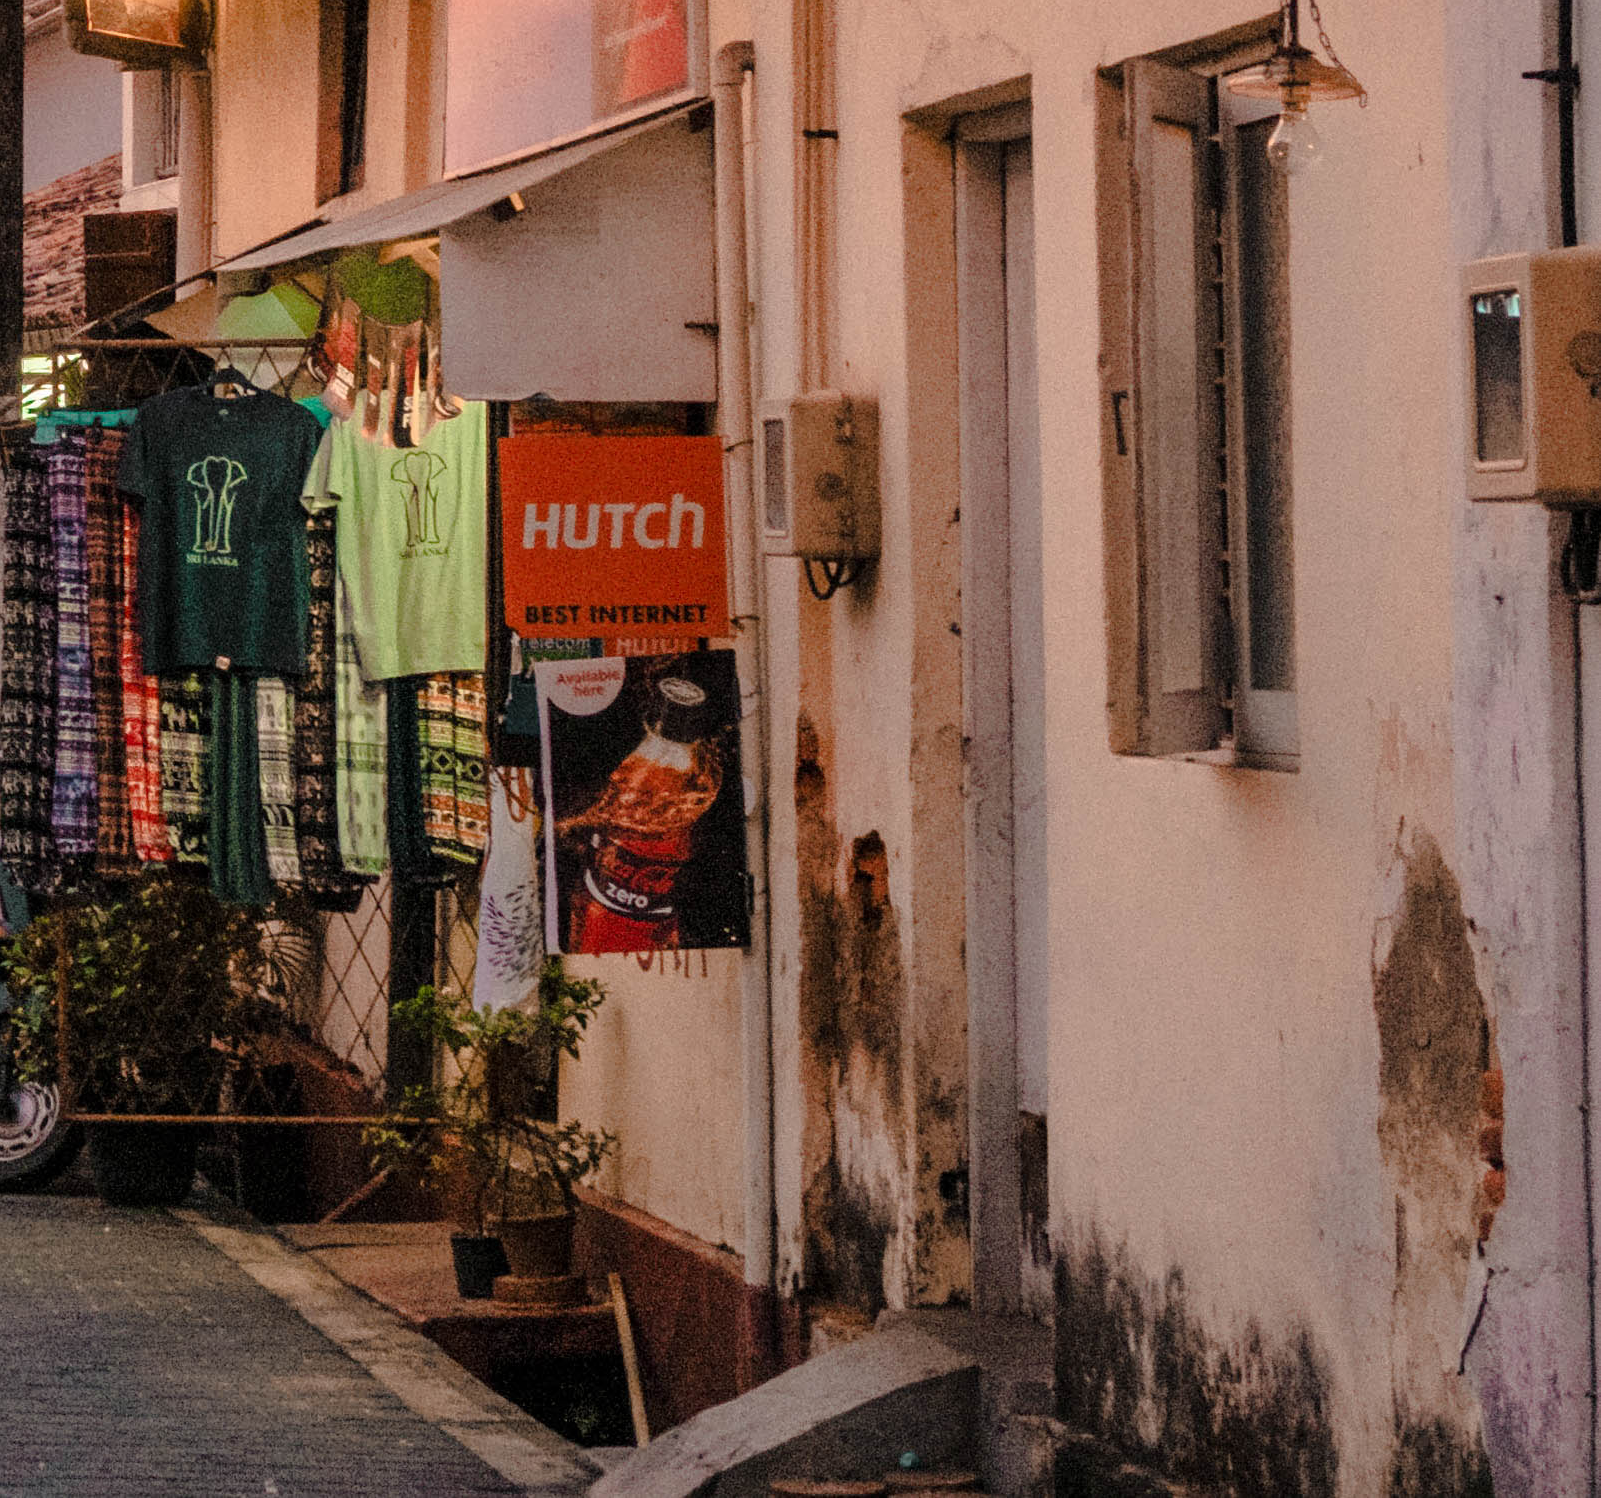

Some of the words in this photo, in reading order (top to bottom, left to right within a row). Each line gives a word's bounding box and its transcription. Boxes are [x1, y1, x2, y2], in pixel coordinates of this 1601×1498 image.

[525, 605, 580, 625] BEST
[590, 603, 709, 624] INTERNET
[557, 670, 622, 686] Available
[573, 685, 605, 697] here
[605, 882, 649, 908] zero
